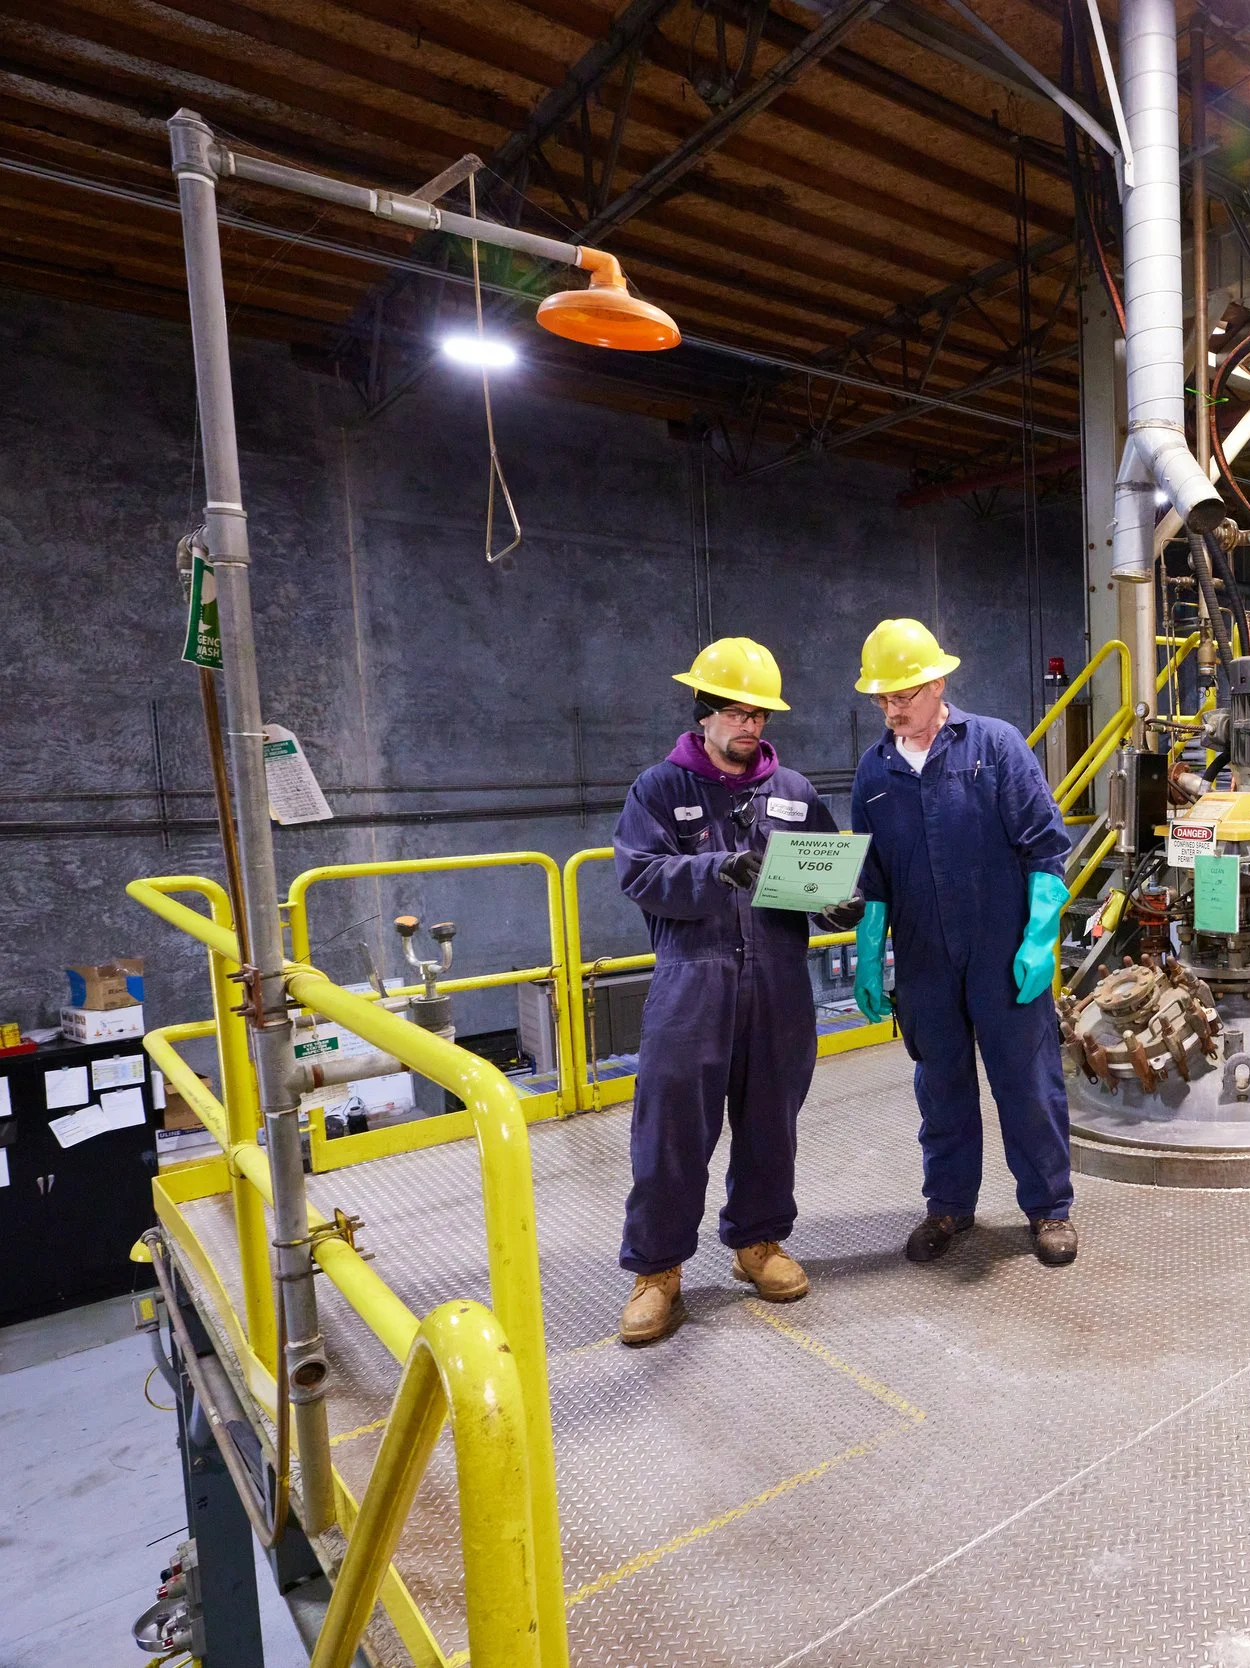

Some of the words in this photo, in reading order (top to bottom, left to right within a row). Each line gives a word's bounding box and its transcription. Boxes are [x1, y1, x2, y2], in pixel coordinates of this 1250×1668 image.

[1177, 828, 1208, 838] DANGER
[790, 840, 835, 848] MANWAY
[1174, 840, 1196, 848] CONFINED
[1196, 841, 1210, 849] SPACE
[1178, 855, 1194, 863] PERMIT
[798, 861, 833, 871] V506
